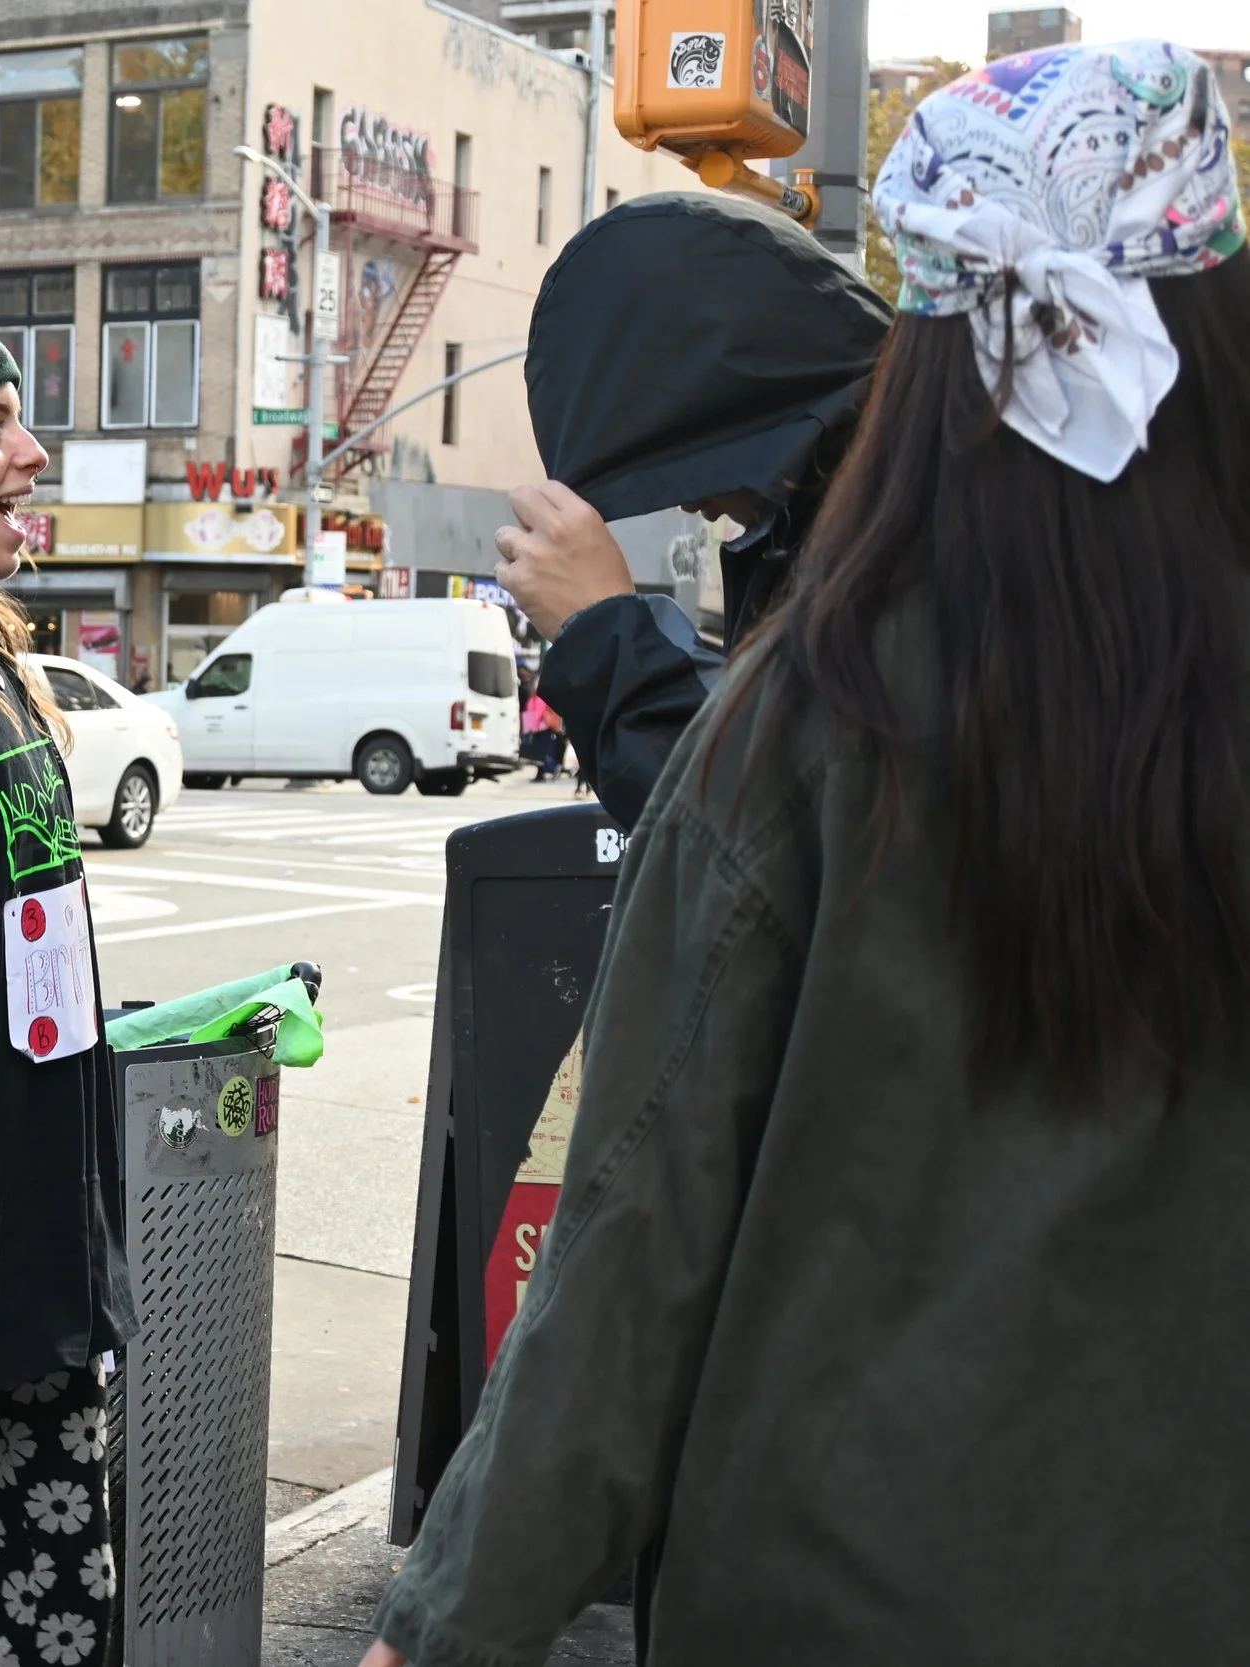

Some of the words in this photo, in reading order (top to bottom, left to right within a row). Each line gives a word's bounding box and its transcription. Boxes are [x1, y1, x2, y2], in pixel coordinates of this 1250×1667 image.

[319, 287, 336, 312] 25
[262, 410, 308, 424] Broadway
[186, 461, 280, 502] Wu's
[26, 907, 39, 936] 3
[37, 1023, 50, 1049] B
[515, 1222, 548, 1273] S
